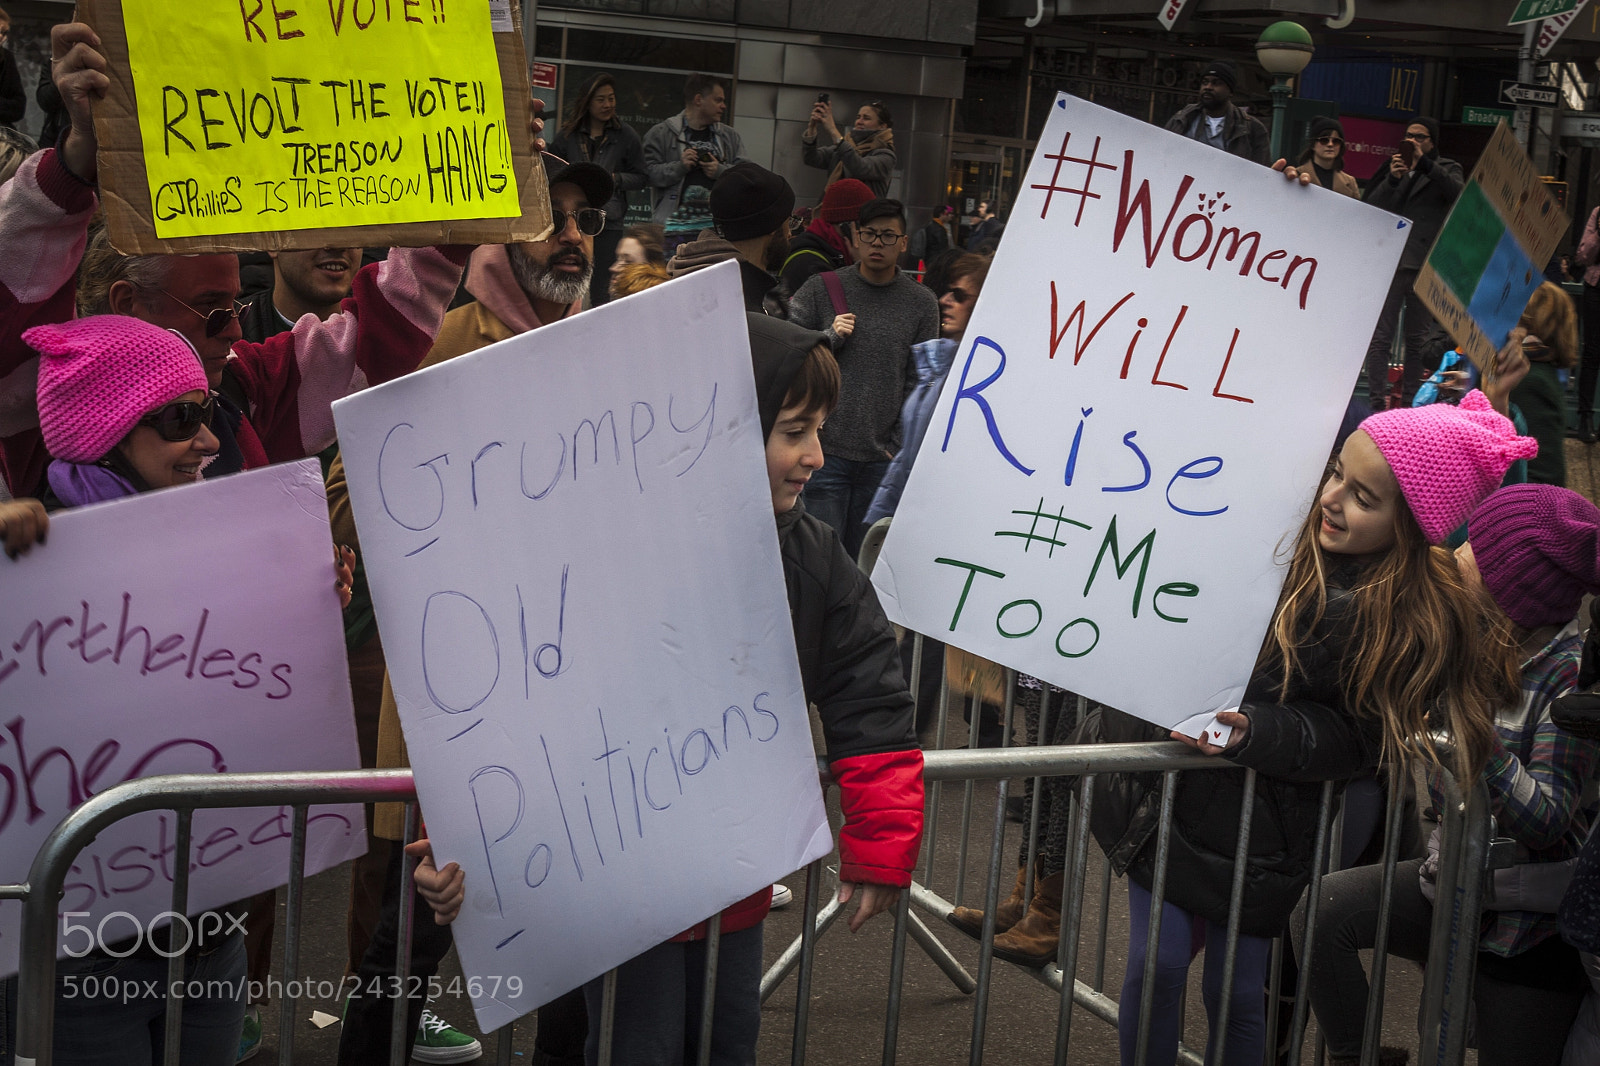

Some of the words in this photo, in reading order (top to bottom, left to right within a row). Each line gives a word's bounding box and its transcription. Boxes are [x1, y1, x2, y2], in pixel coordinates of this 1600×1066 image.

[162, 76, 311, 158] REVOLT
[319, 79, 391, 127] THE
[1386, 67, 1418, 112] JAZZ
[1511, 88, 1529, 98] ONE
[1533, 92, 1553, 101] WAY
[255, 181, 288, 214] IS
[337, 174, 421, 207] REASON
[282, 136, 402, 176] TREASON
[1346, 140, 1369, 153] ncoln
[1031, 132, 1318, 310] #Women
[378, 382, 718, 531] Grumpy
[941, 336, 1229, 517] Rise
[994, 497, 1200, 623] #Me
[0, 592, 292, 699] rtheless
[422, 563, 570, 714] Old
[468, 691, 780, 920] Politicians
